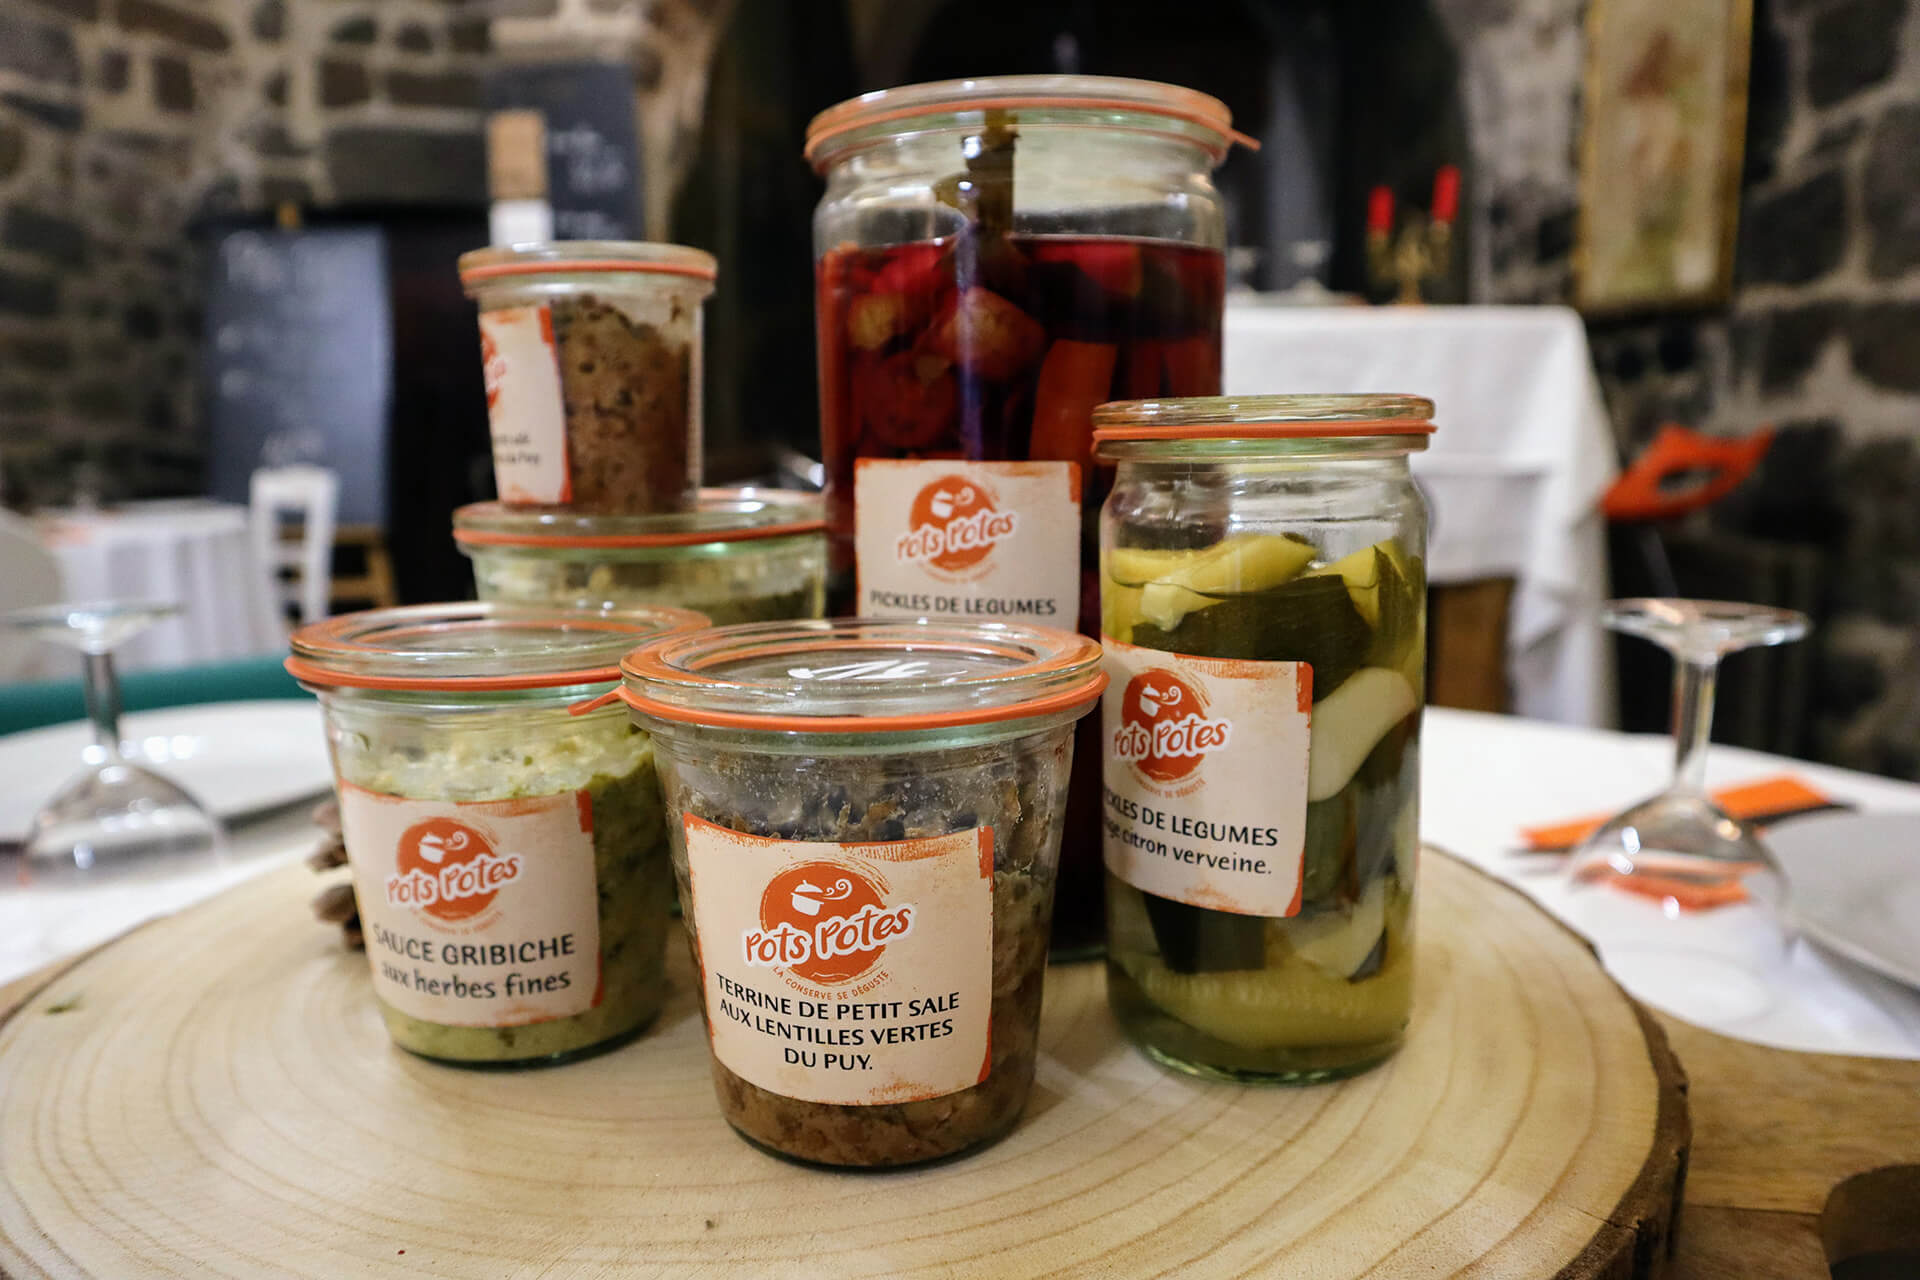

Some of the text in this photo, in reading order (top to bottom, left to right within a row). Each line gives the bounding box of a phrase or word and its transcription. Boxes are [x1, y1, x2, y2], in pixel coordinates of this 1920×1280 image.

[870, 590, 1056, 615] PICKLES DE LEGUMES
[1115, 714, 1228, 756] Pots Potes
[1142, 807, 1165, 830] DE
[1172, 816, 1278, 846] LEGUMES
[1122, 826, 1166, 856] citron
[1173, 847, 1272, 874] verveine.
[388, 856, 520, 904] Pots Potes
[372, 923, 575, 965] SAUCE GRIBICHE
[745, 907, 912, 963] Pots Potes
[382, 963, 571, 998] aux herbes fines
[716, 973, 960, 1020] TERRINE DE PETIT SALE
[773, 966, 889, 1000] LA CONSERVE SE DÉGUSTE
[720, 999, 953, 1046] AUX LENTILLES VERTES
[784, 1047, 873, 1070] DU PUY.
